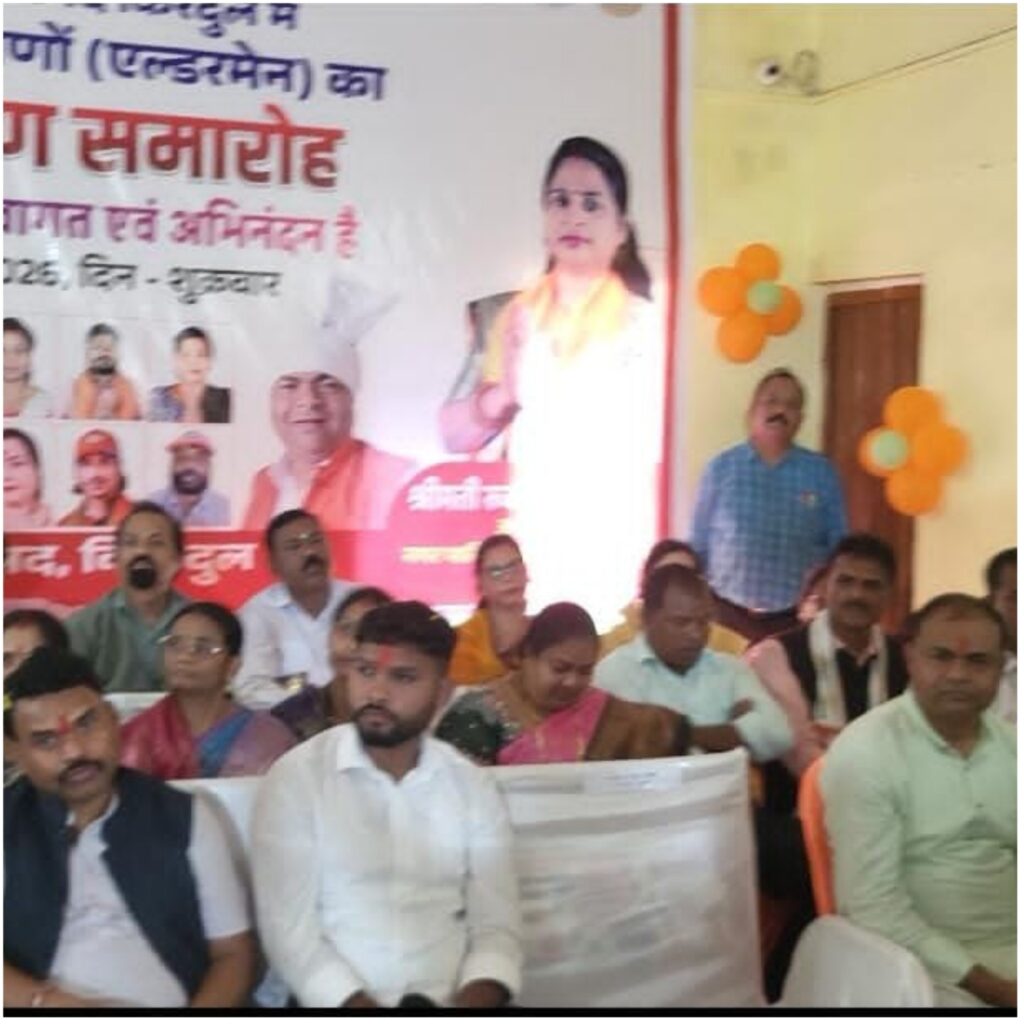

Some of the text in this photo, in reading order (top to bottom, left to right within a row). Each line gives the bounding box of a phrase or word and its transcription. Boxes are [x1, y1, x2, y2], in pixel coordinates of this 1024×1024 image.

[88, 38, 311, 101] (एल्डरमेन)
[324, 62, 389, 101] का
[71, 104, 349, 189] समारोह
[103, 196, 160, 243] एवं
[170, 196, 327, 253] अभिनंदन
[335, 203, 359, 259] है
